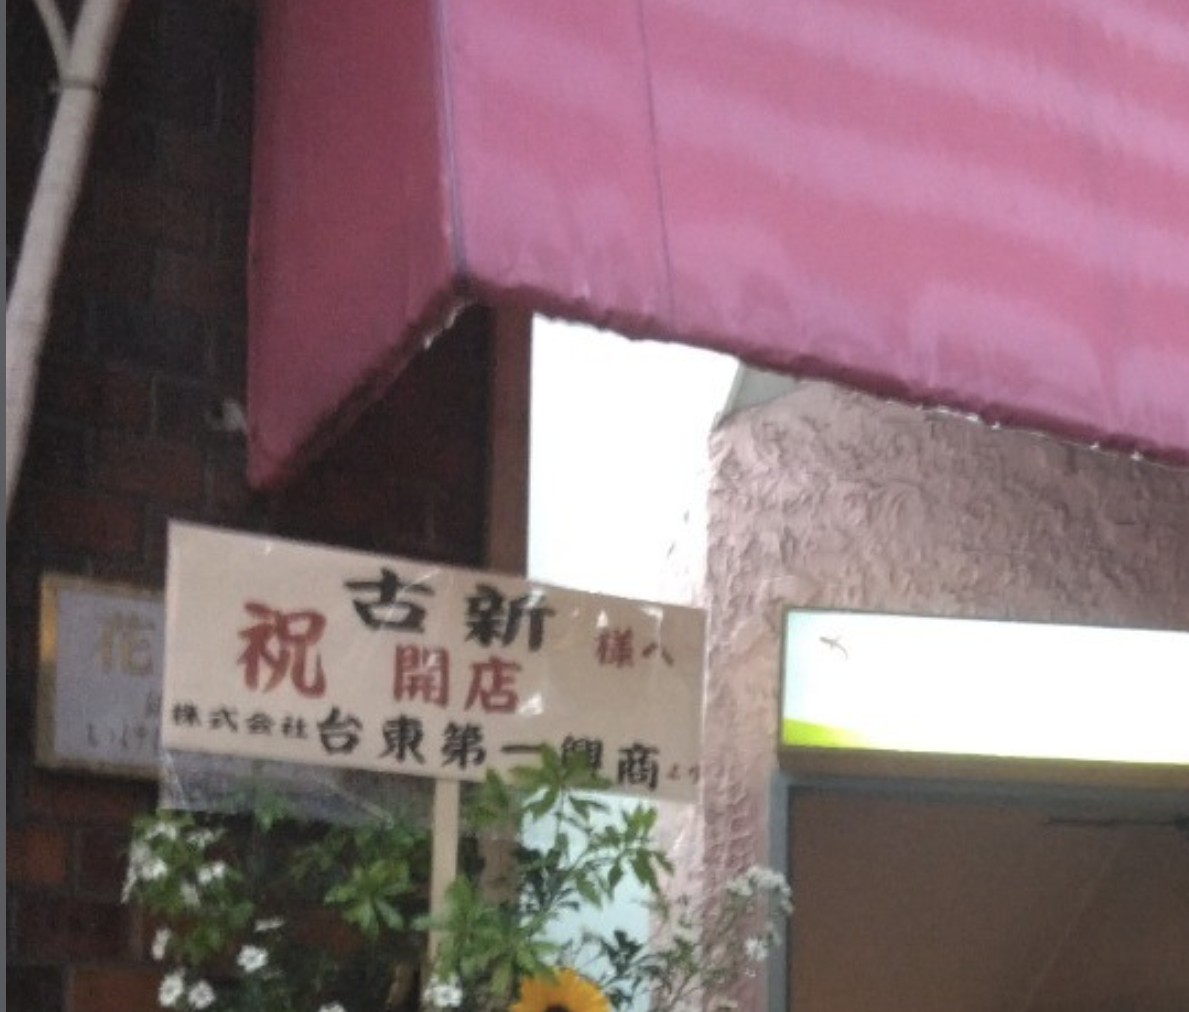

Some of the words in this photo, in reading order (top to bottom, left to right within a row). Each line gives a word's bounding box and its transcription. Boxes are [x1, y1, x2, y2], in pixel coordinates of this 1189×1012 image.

[237, 600, 326, 699] 祝
[343, 567, 555, 651] 古新
[392, 644, 523, 714] 開店
